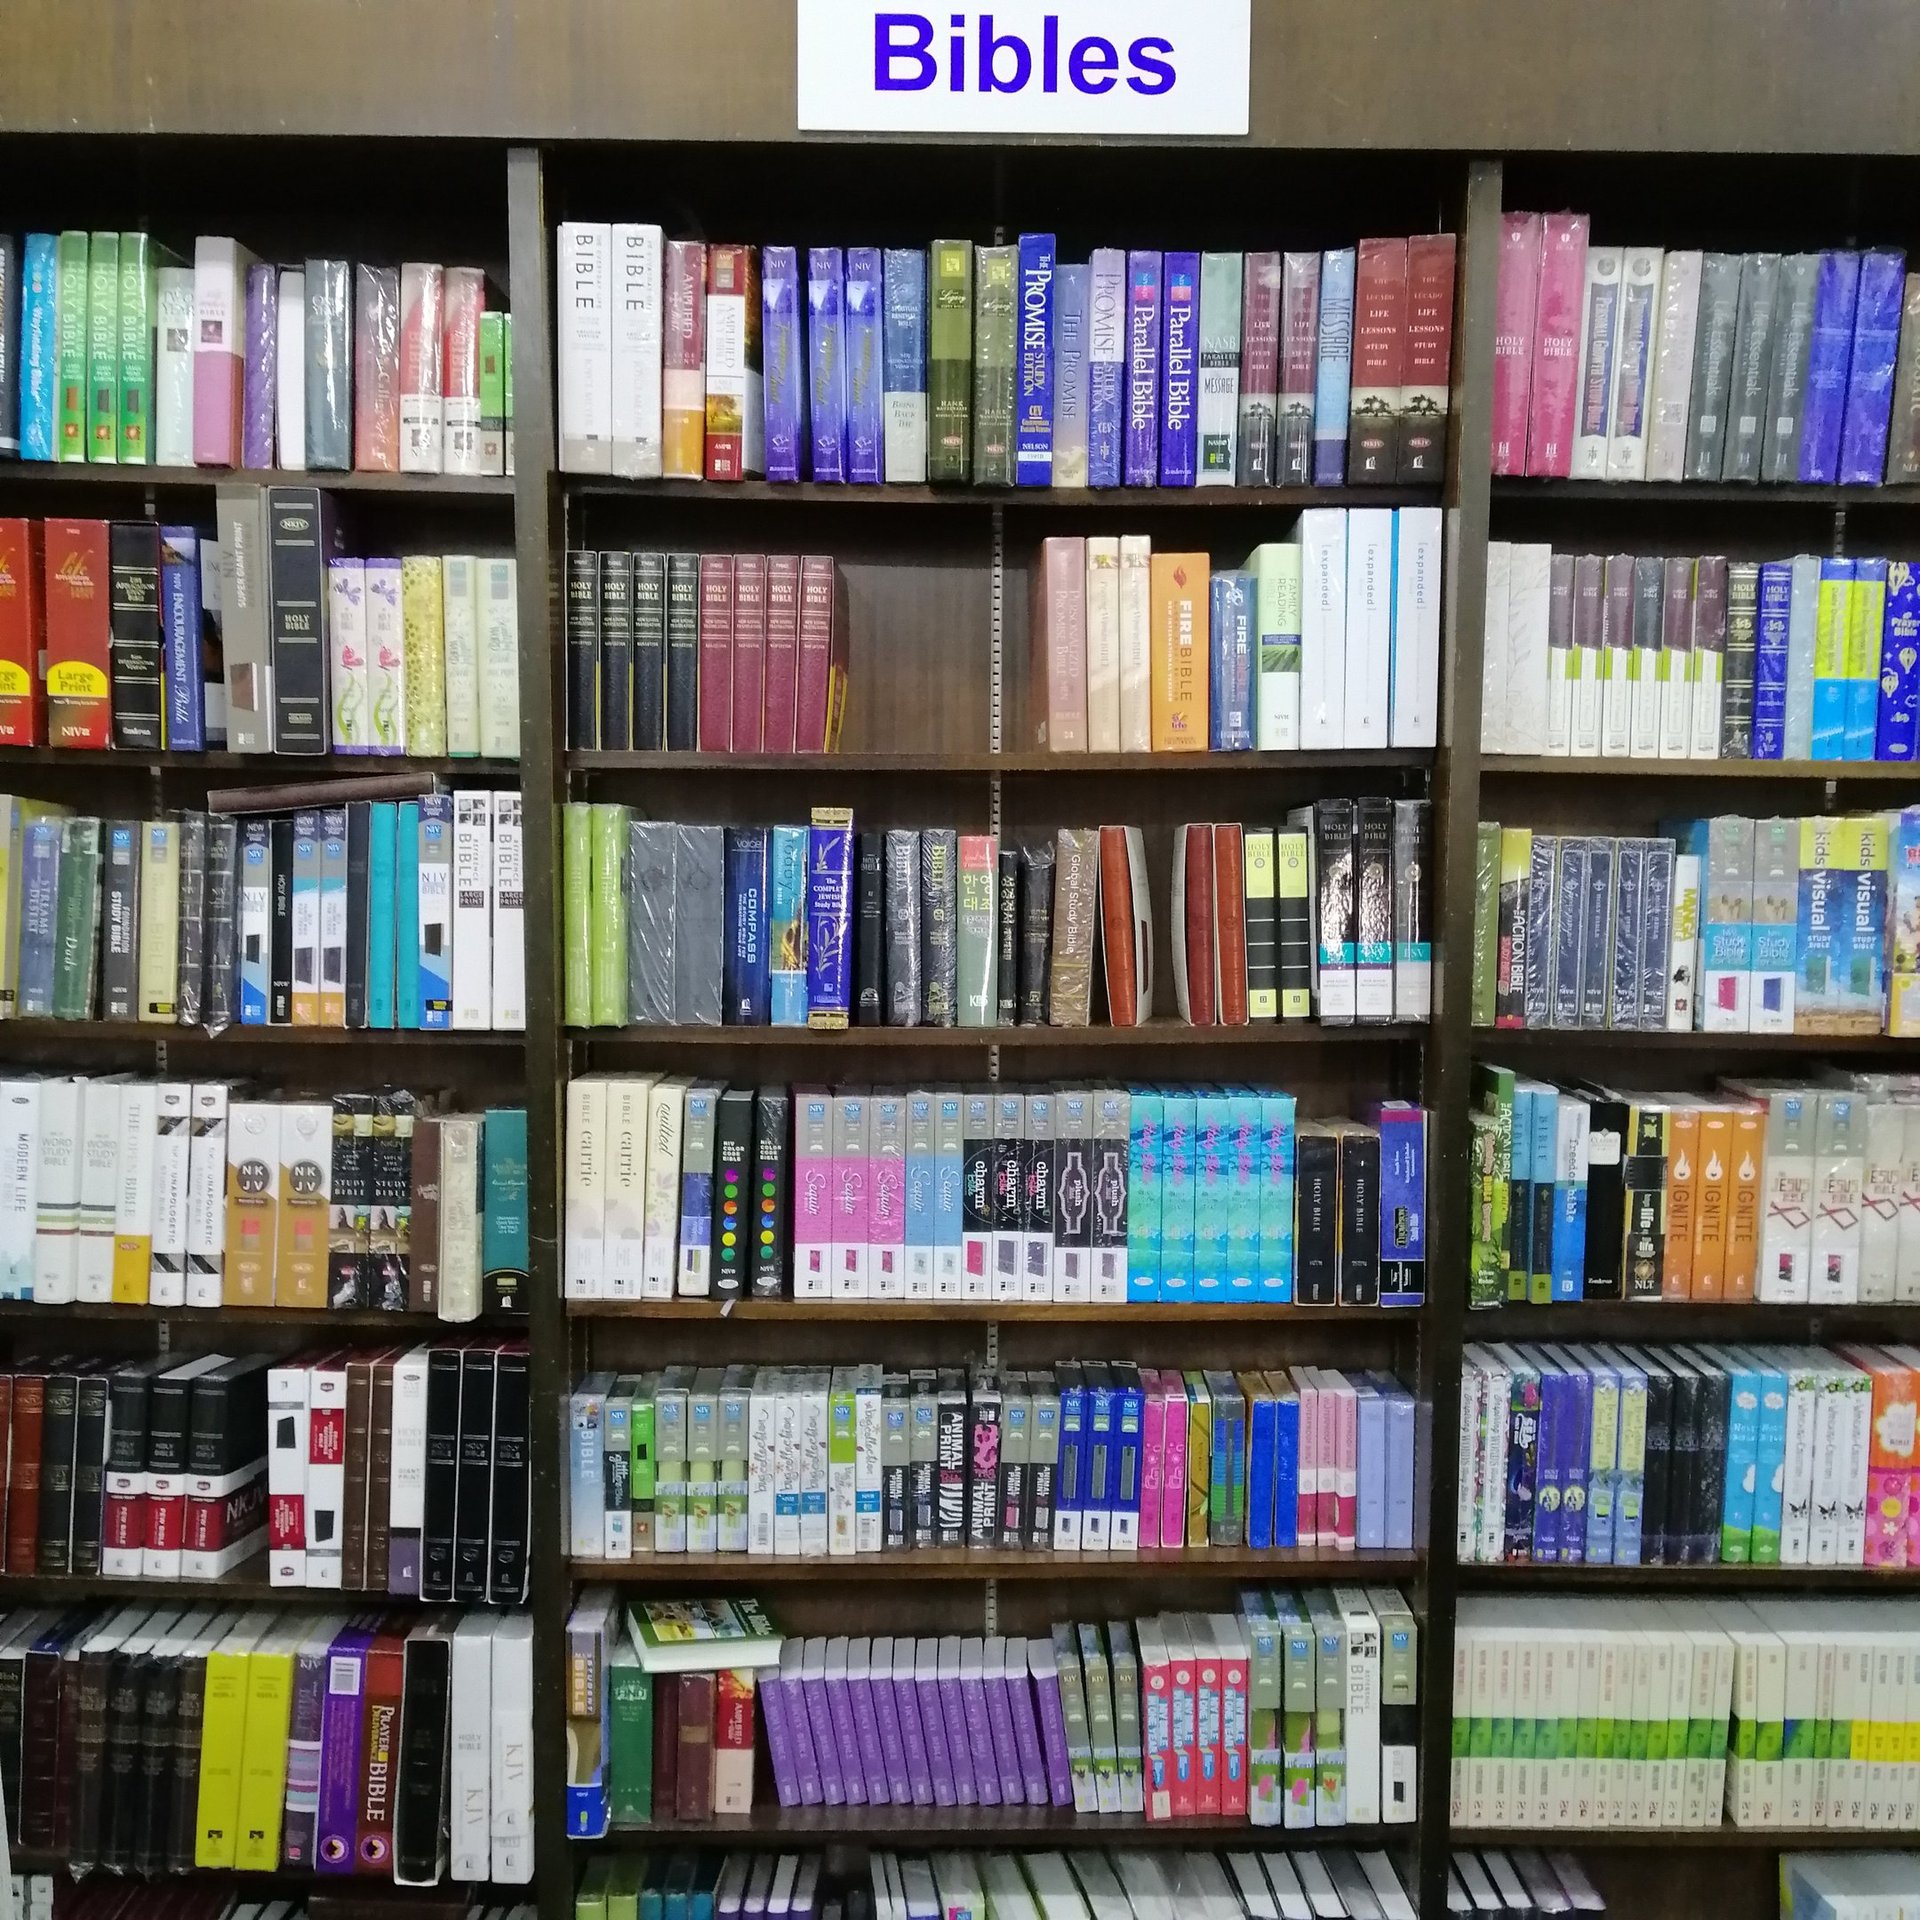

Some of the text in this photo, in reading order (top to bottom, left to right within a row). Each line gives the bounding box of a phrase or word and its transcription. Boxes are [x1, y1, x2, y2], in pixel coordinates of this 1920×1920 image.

[875, 13, 1176, 95] Bibles
[576, 235, 593, 308] BIBLE
[626, 237, 644, 310] BIBLE
[771, 260, 786, 268] NIV
[816, 261, 832, 270] NIV
[681, 273, 693, 338] AMPLIFIED
[1024, 255, 1052, 350] THE PROMISE
[1093, 273, 1121, 355] PROMISE
[1418, 308, 1437, 316] LIFE
[1204, 336, 1235, 349] NASB
[1321, 298, 1350, 362] MESSAGE
[1361, 326, 1396, 334] LESSONS
[1408, 325, 1444, 333] LESSONS
[1496, 337, 1524, 346] HOLY
[1544, 338, 1572, 347] HOLY
[1496, 347, 1524, 355] BIBLE
[1544, 348, 1572, 357] BIBLE
[1023, 353, 1033, 396] EDITION
[1034, 353, 1046, 390] STUDY
[1062, 311, 1082, 419] THE PROMISE
[1132, 305, 1155, 429] Parallel Bible
[1168, 306, 1191, 430] Parallel Bible
[1204, 377, 1234, 394] MESSAGE
[571, 582, 592, 590] HOLY
[571, 592, 592, 600] BIBLE
[604, 583, 625, 591] HOLY
[604, 592, 626, 600] BIBLE
[638, 583, 659, 591] HOLY
[638, 592, 659, 600] BIBLE
[672, 584, 693, 592] HOLY
[672, 594, 693, 602] BIBLE
[706, 585, 727, 593] HOLY
[706, 594, 727, 602] BIBLE
[739, 584, 760, 593] HOLY
[739, 594, 760, 602] BIBLE
[772, 584, 793, 593] HOLY
[772, 594, 793, 602] BIBLE
[807, 586, 828, 594] HOLY
[807, 595, 828, 603] BIBLE
[1289, 578, 1297, 617] FAMILY
[1732, 592, 1756, 600] BIBLE
[1277, 578, 1286, 627] READING
[285, 615, 310, 623] HOLY
[285, 622, 310, 631] BIBLE
[1180, 600, 1192, 701] FIRE BIBLE
[58, 670, 94, 682] Large
[60, 681, 93, 693] Print
[424, 797, 443, 805] NEW
[247, 824, 264, 832] NEW
[459, 834, 471, 887] BIBLE
[499, 834, 512, 887] BIBLE
[422, 885, 446, 895] BIBLE
[1811, 831, 1831, 931] kids visual
[1856, 832, 1876, 932] kids visual
[1065, 855, 1080, 953] Global Study Bible
[111, 892, 122, 953] STUDY BIBLE
[747, 888, 757, 963] COMPASS
[1510, 916, 1526, 994] ACTION BIBLE
[1759, 936, 1790, 949] Study
[1760, 948, 1788, 958] Bible
[692, 1100, 706, 1108] NIV
[42, 1138, 72, 1146] WORD
[43, 1148, 71, 1157] STUDY
[88, 1141, 117, 1149] WORD
[88, 1150, 115, 1158] STUDY
[580, 1094, 597, 1187] BIBLE carrie
[620, 1095, 636, 1187] BIBLE carrie
[14, 1133, 29, 1212] MODERN LIFE
[975, 1160, 988, 1209] charm
[1007, 1160, 1019, 1208] charm
[1036, 1161, 1049, 1209] charm
[1566, 1139, 1579, 1223] freedom bible
[1074, 1180, 1083, 1206] plush
[1111, 1179, 1119, 1207] plush
[1312, 1178, 1322, 1232] HOLY BIBLE
[1356, 1179, 1364, 1234] HOLY BIBLE
[205, 1173, 214, 1245] UNAPOLOGETIC
[1640, 1207, 1654, 1229] life
[1670, 1184, 1690, 1242] IGNITE
[1702, 1184, 1721, 1242] IGNITE
[1735, 1185, 1755, 1242] IGNITE
[1634, 1280, 1655, 1289] NLT
[940, 1425, 951, 1469] PRINT
[951, 1413, 964, 1469] ANIMAL
[581, 1431, 594, 1479] BIBLE
[972, 1482, 984, 1539] ANIMAL
[983, 1485, 996, 1527] PRINT
[575, 1660, 584, 1713] BIBLE
[1063, 1675, 1077, 1683] KJV
[1351, 1665, 1364, 1715] BIBLE
[367, 1705, 395, 1821] PRAYER BIBLE
[505, 1744, 523, 1780] KJV
